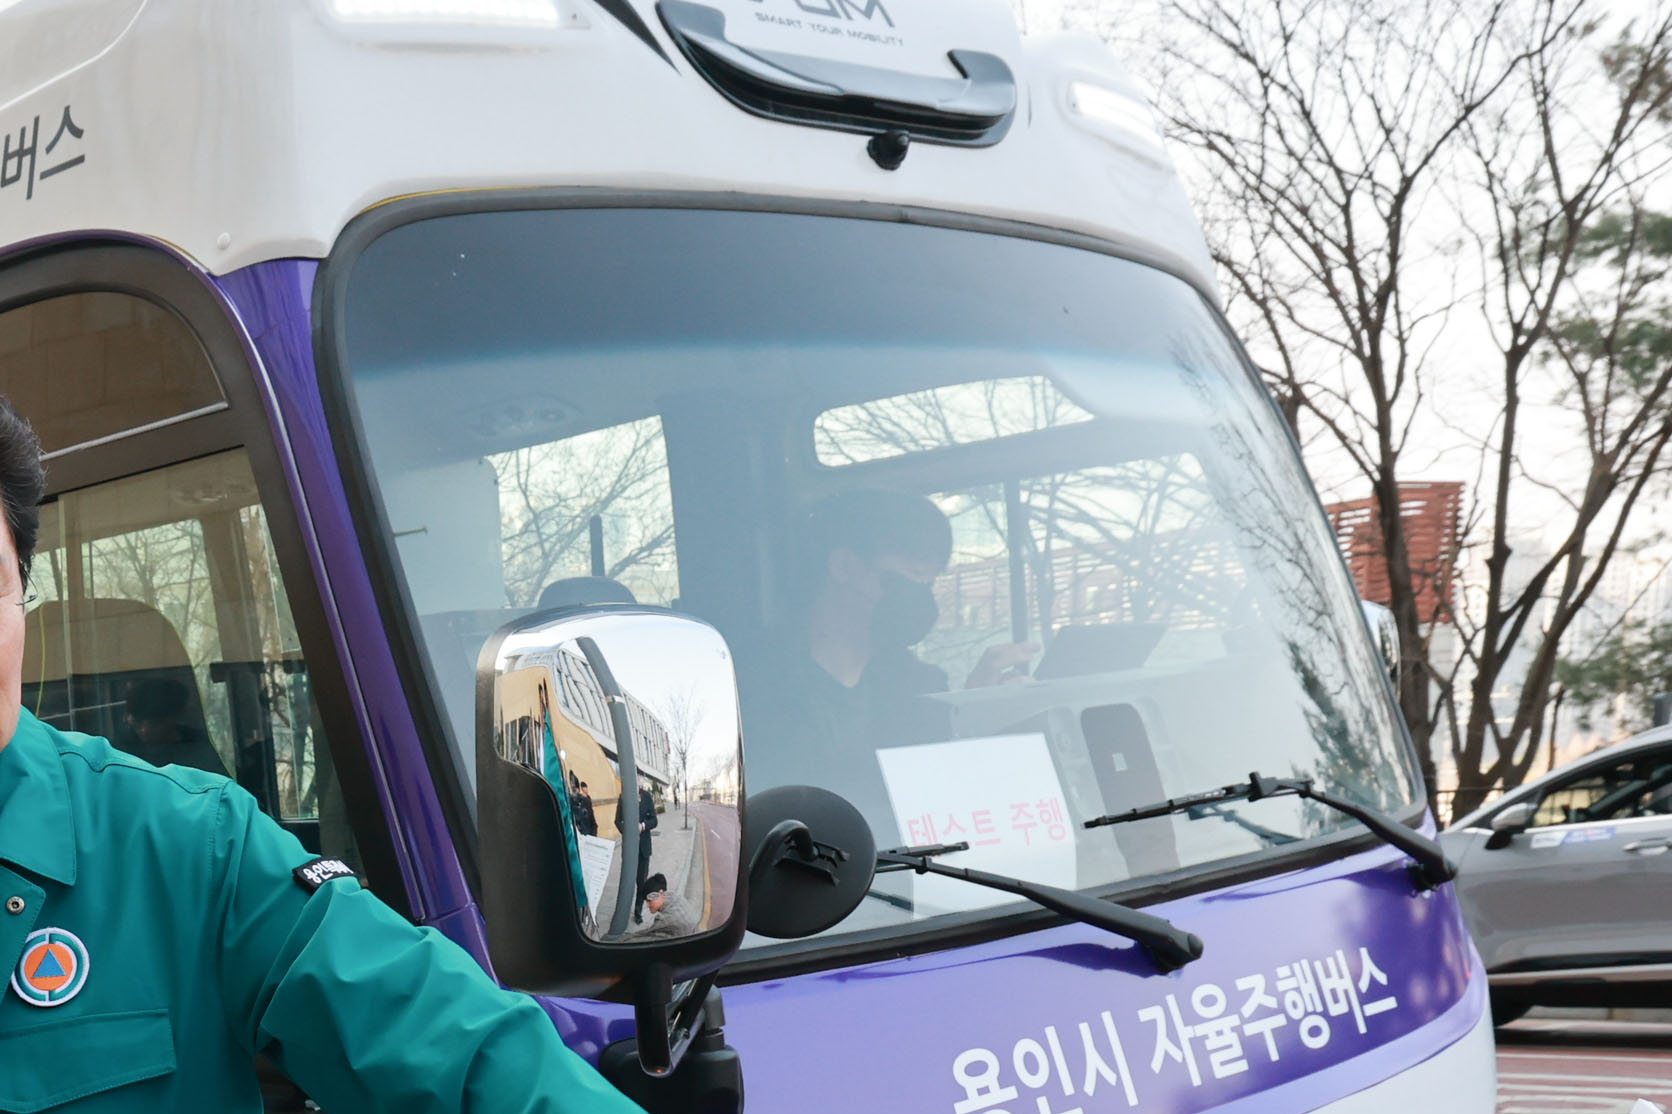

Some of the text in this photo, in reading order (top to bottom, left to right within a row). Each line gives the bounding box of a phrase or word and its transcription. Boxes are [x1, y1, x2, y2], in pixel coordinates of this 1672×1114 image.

[906, 798, 1067, 848] 테스트 주행
[1146, 947, 1397, 1088] 자율주행버스
